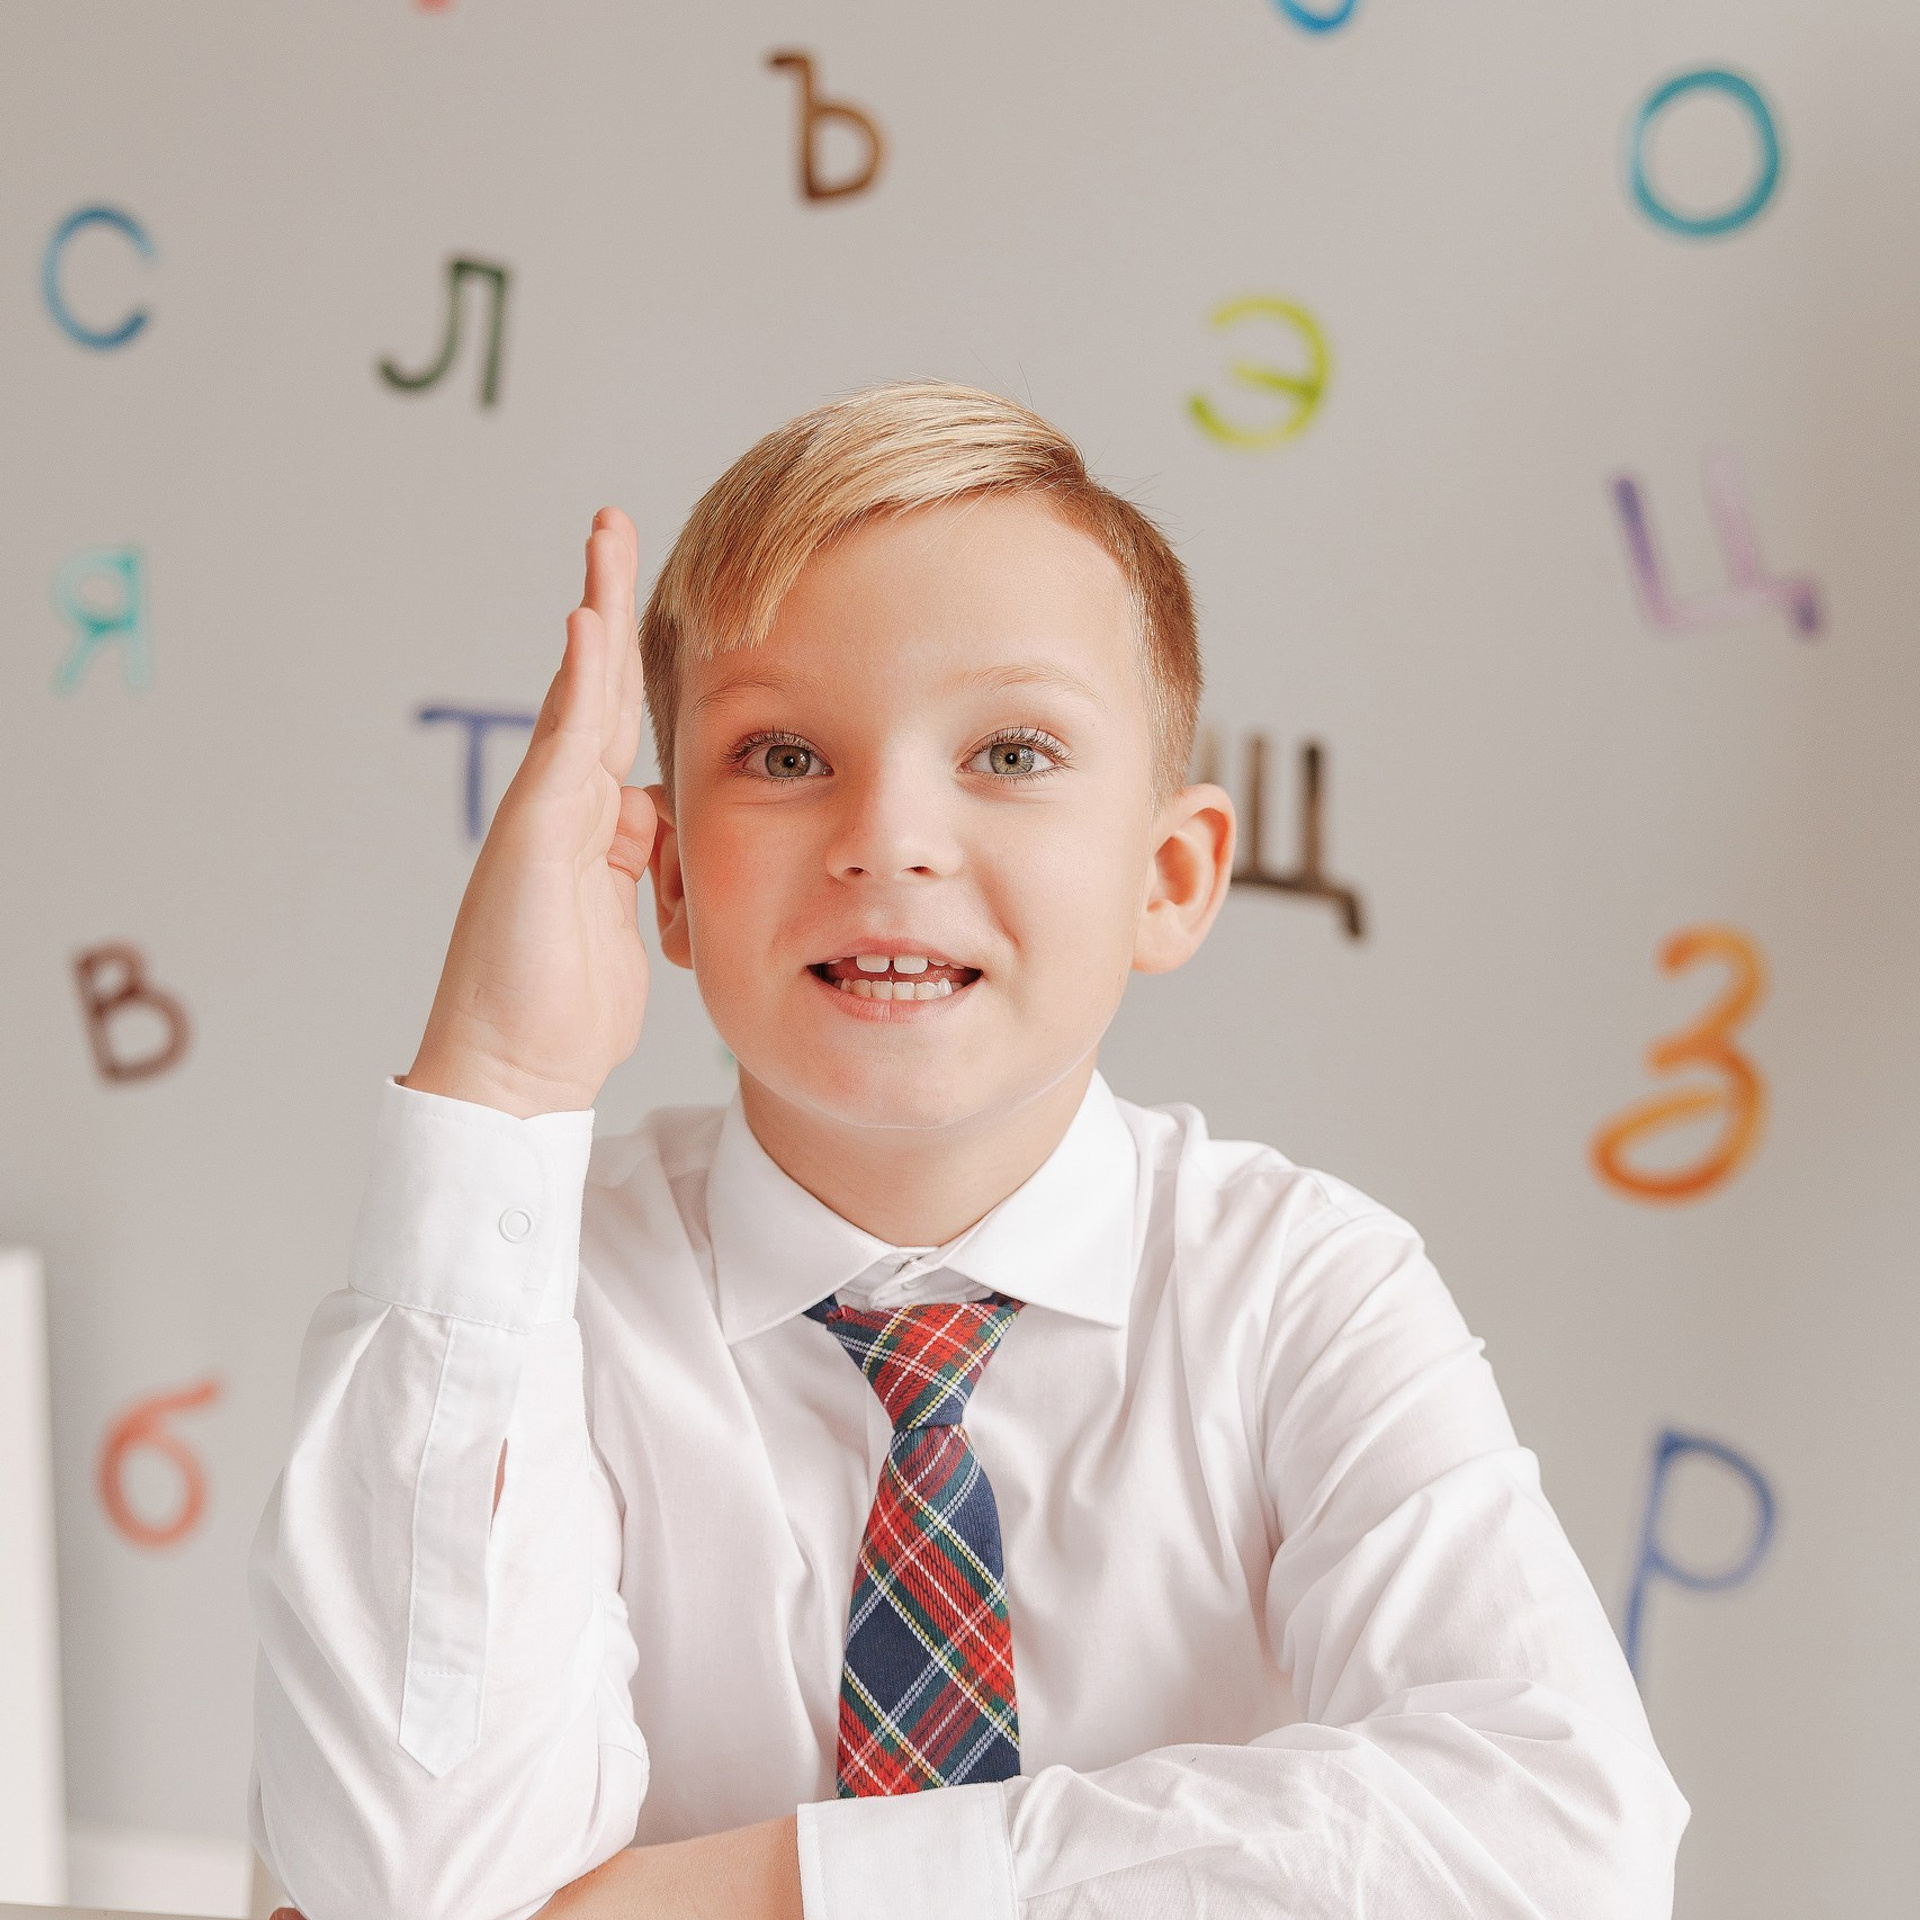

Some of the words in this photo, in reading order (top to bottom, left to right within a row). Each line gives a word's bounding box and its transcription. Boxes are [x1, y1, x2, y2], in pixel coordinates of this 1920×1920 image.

[765, 48, 889, 208] Ъ
[40, 202, 159, 352] С
[374, 253, 514, 412] Л
[1184, 295, 1336, 450] Э
[53, 546, 149, 694] Я
[1610, 450, 1828, 640] Ц
[413, 702, 537, 844] Т
[74, 940, 193, 1087] В
